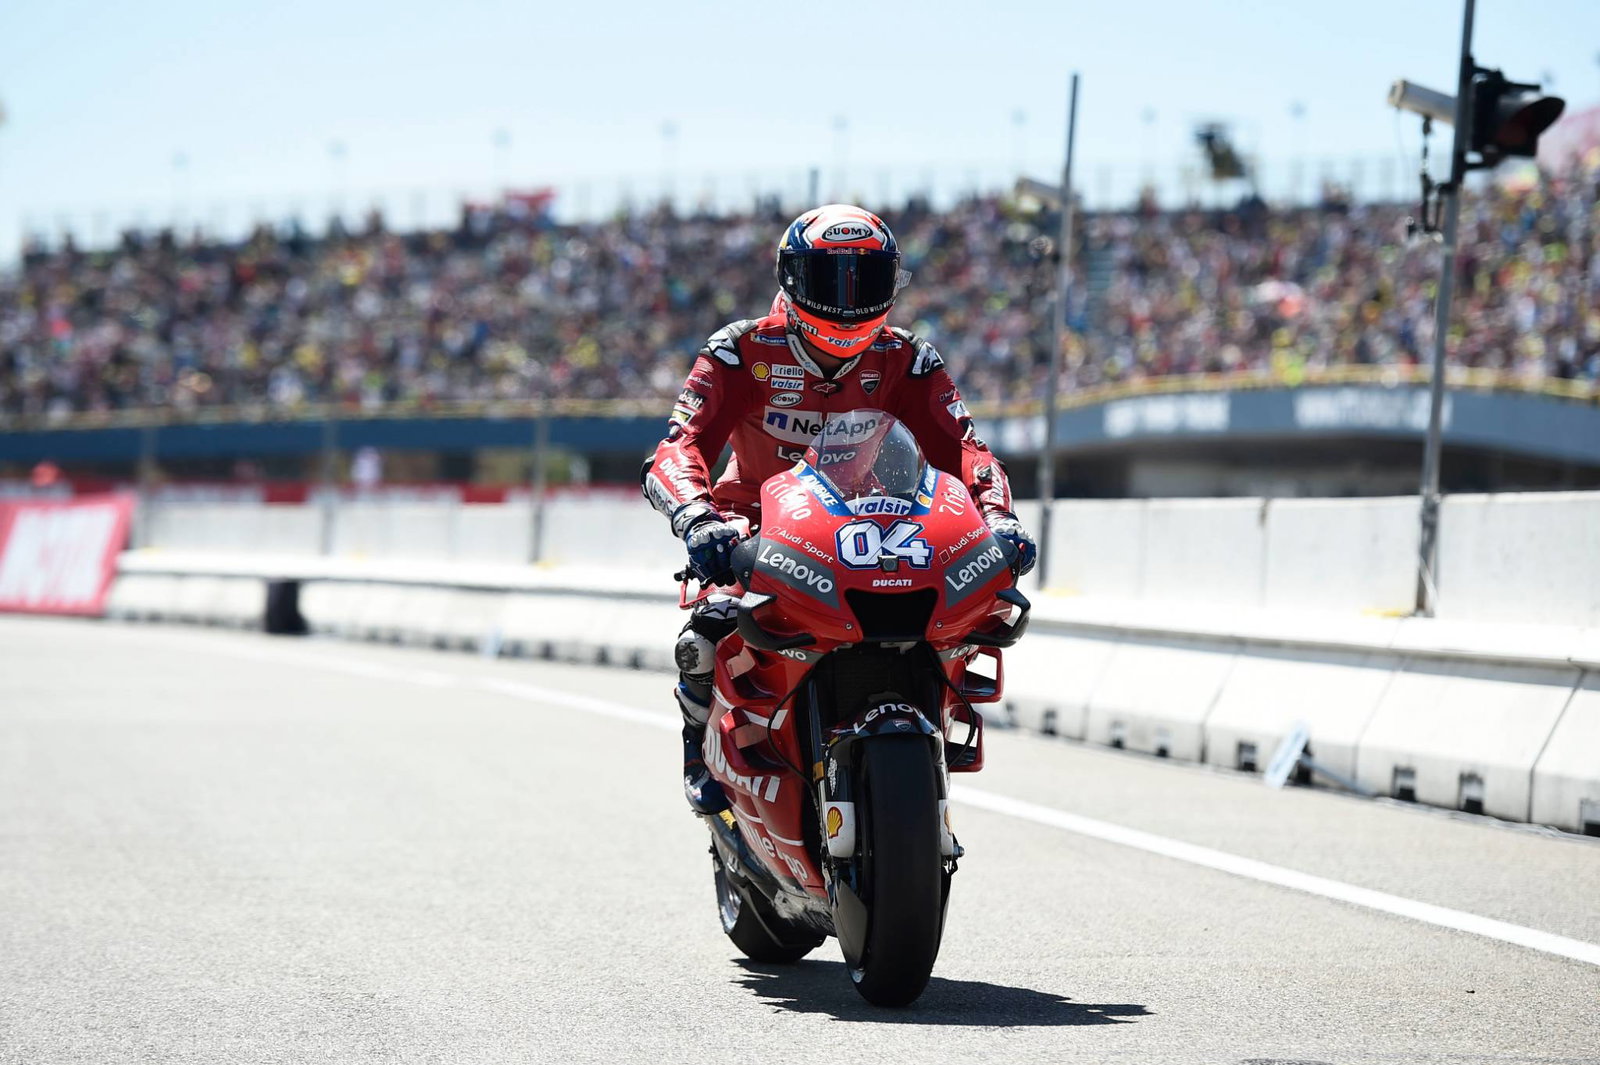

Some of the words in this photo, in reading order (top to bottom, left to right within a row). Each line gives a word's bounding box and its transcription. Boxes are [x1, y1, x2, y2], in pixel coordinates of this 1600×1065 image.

[826, 227, 870, 237] SUOMY
[806, 299, 822, 310] WILD
[822, 304, 843, 314] WEST
[779, 366, 804, 376] riello
[771, 380, 803, 389] valsir
[791, 418, 876, 437] NetApp
[777, 445, 857, 465] Leovo
[854, 498, 910, 515] valsir
[778, 529, 804, 545] Audi
[802, 541, 834, 564] Sport
[836, 518, 935, 571] 04
[948, 533, 969, 554] Audi
[757, 545, 833, 593] Lenovo
[945, 545, 1004, 592] Lenovo
[872, 579, 912, 587] DUCATI
